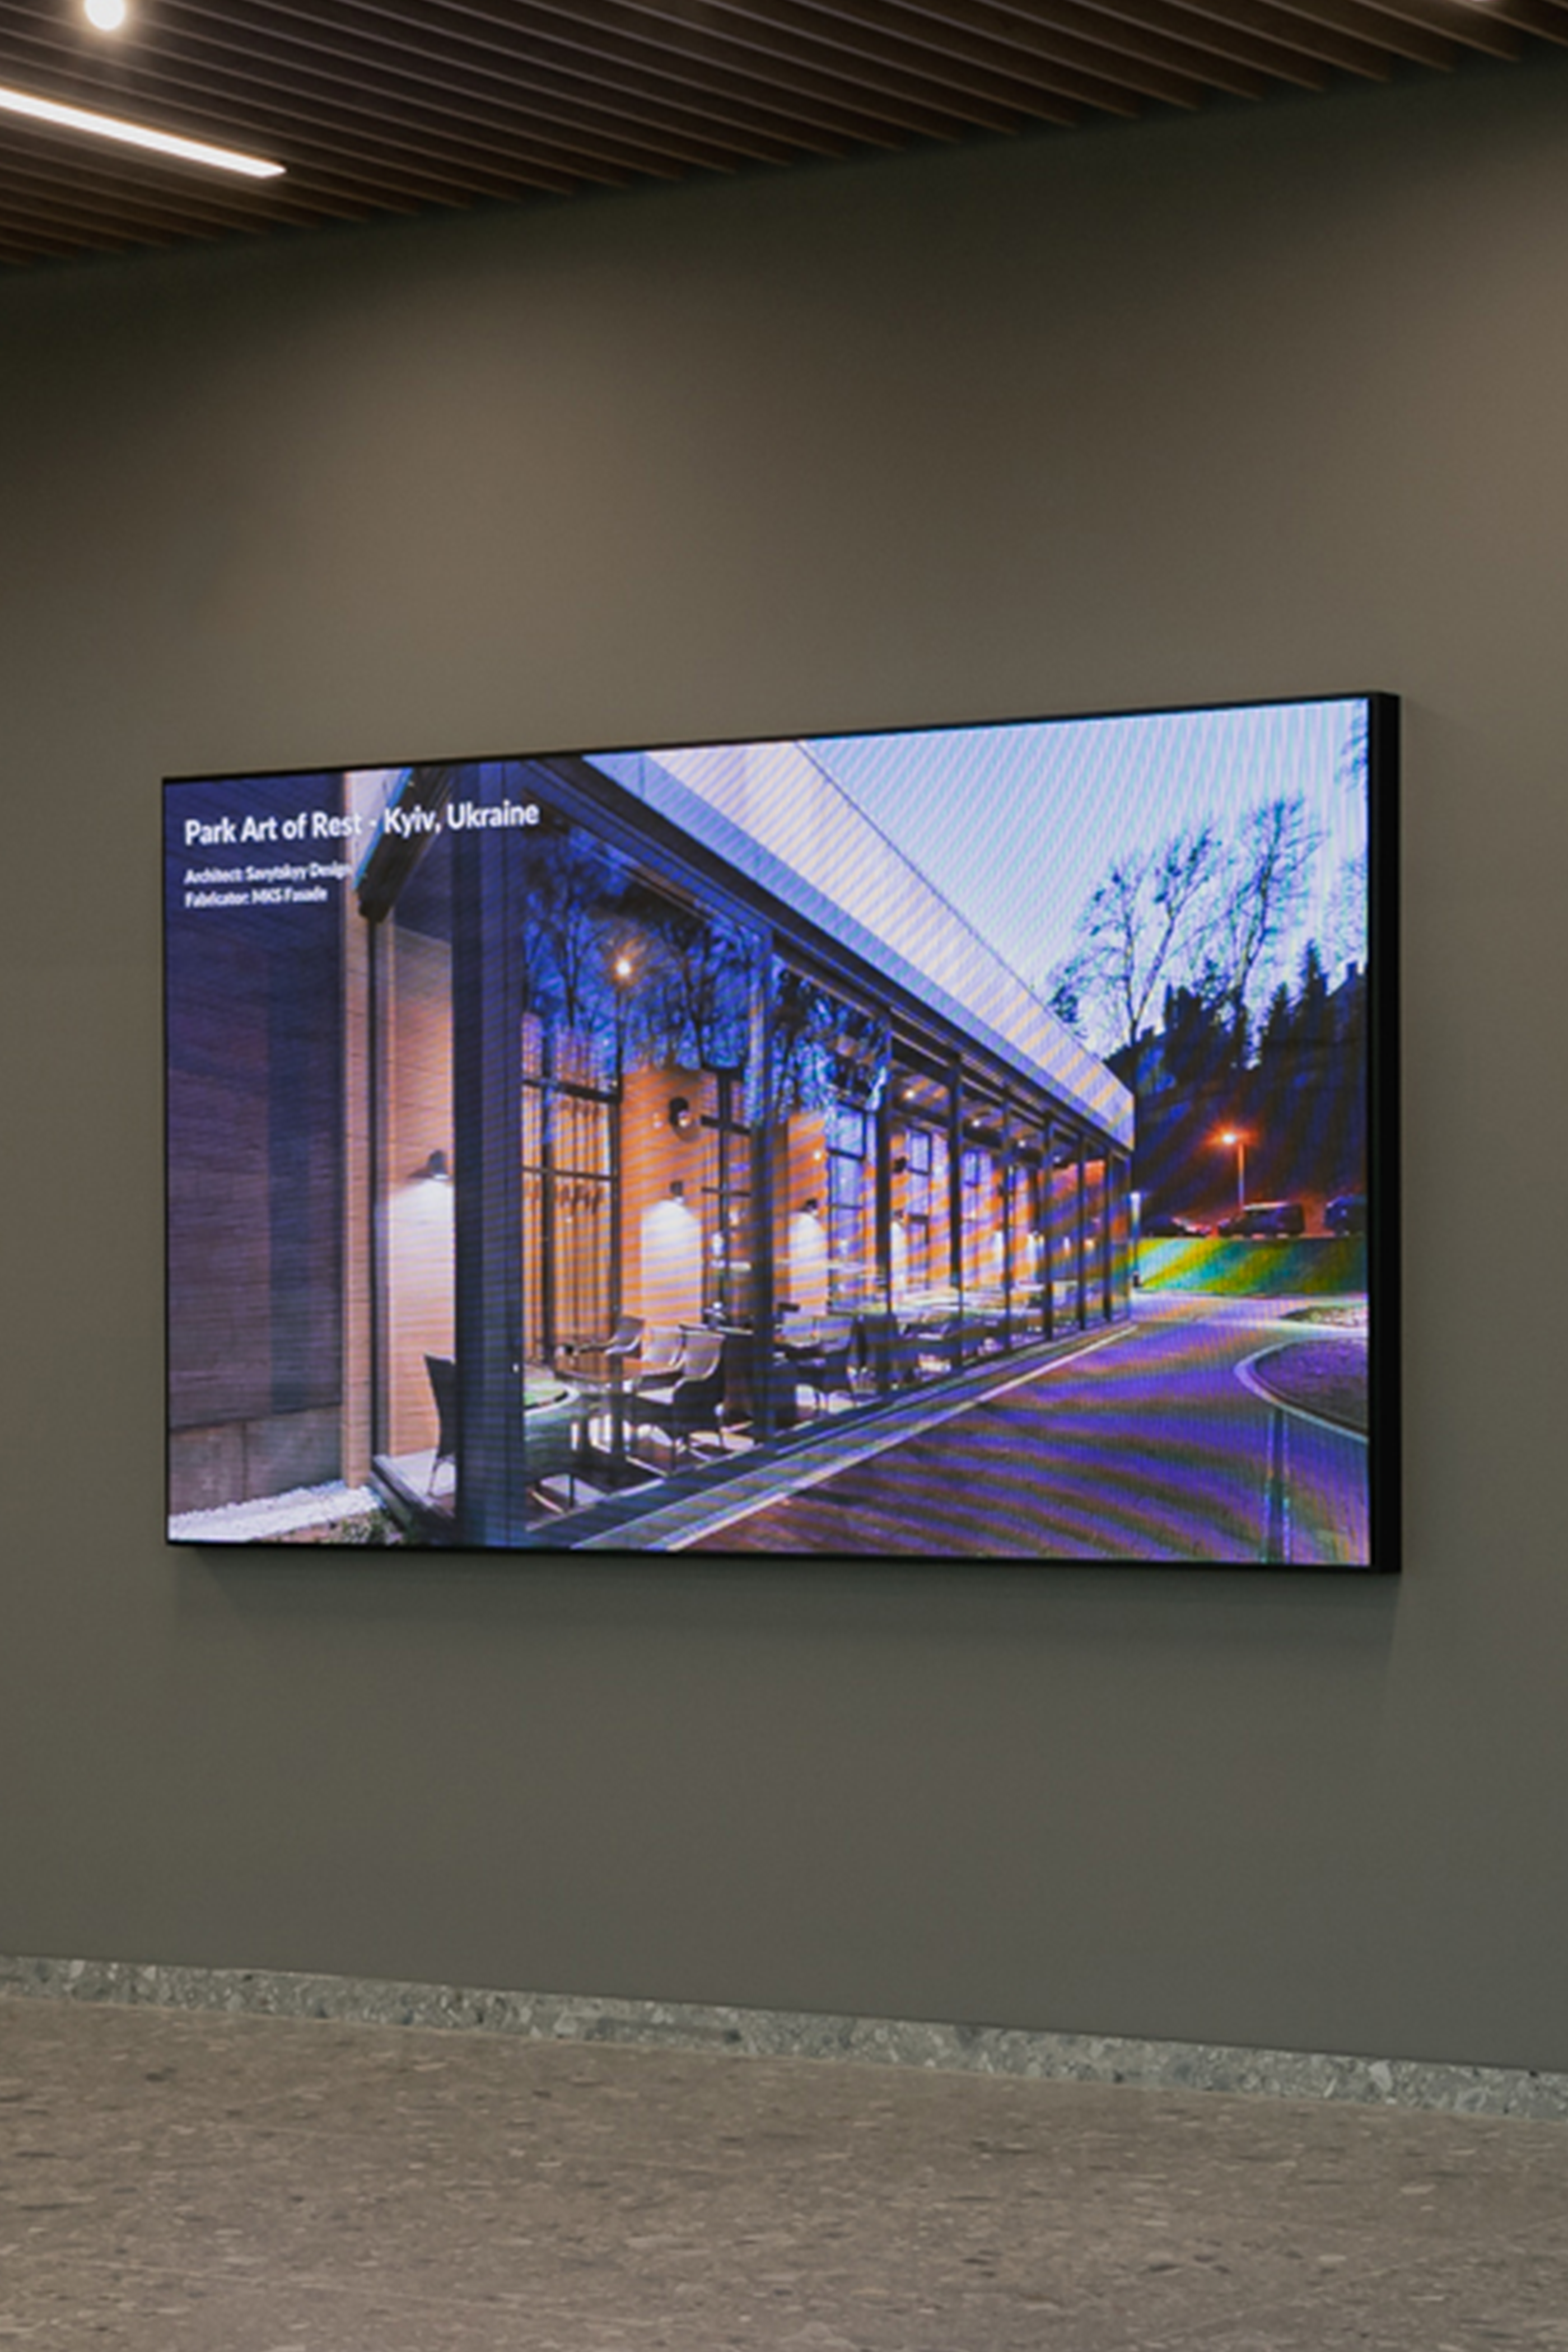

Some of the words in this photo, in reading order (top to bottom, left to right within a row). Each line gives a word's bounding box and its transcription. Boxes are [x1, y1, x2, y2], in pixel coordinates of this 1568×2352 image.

[185, 818, 236, 845] Park
[241, 814, 278, 841] Art
[281, 811, 309, 839] of
[312, 811, 362, 837] Rest
[384, 805, 441, 835] Kyiv,
[447, 800, 539, 829] Ukraine
